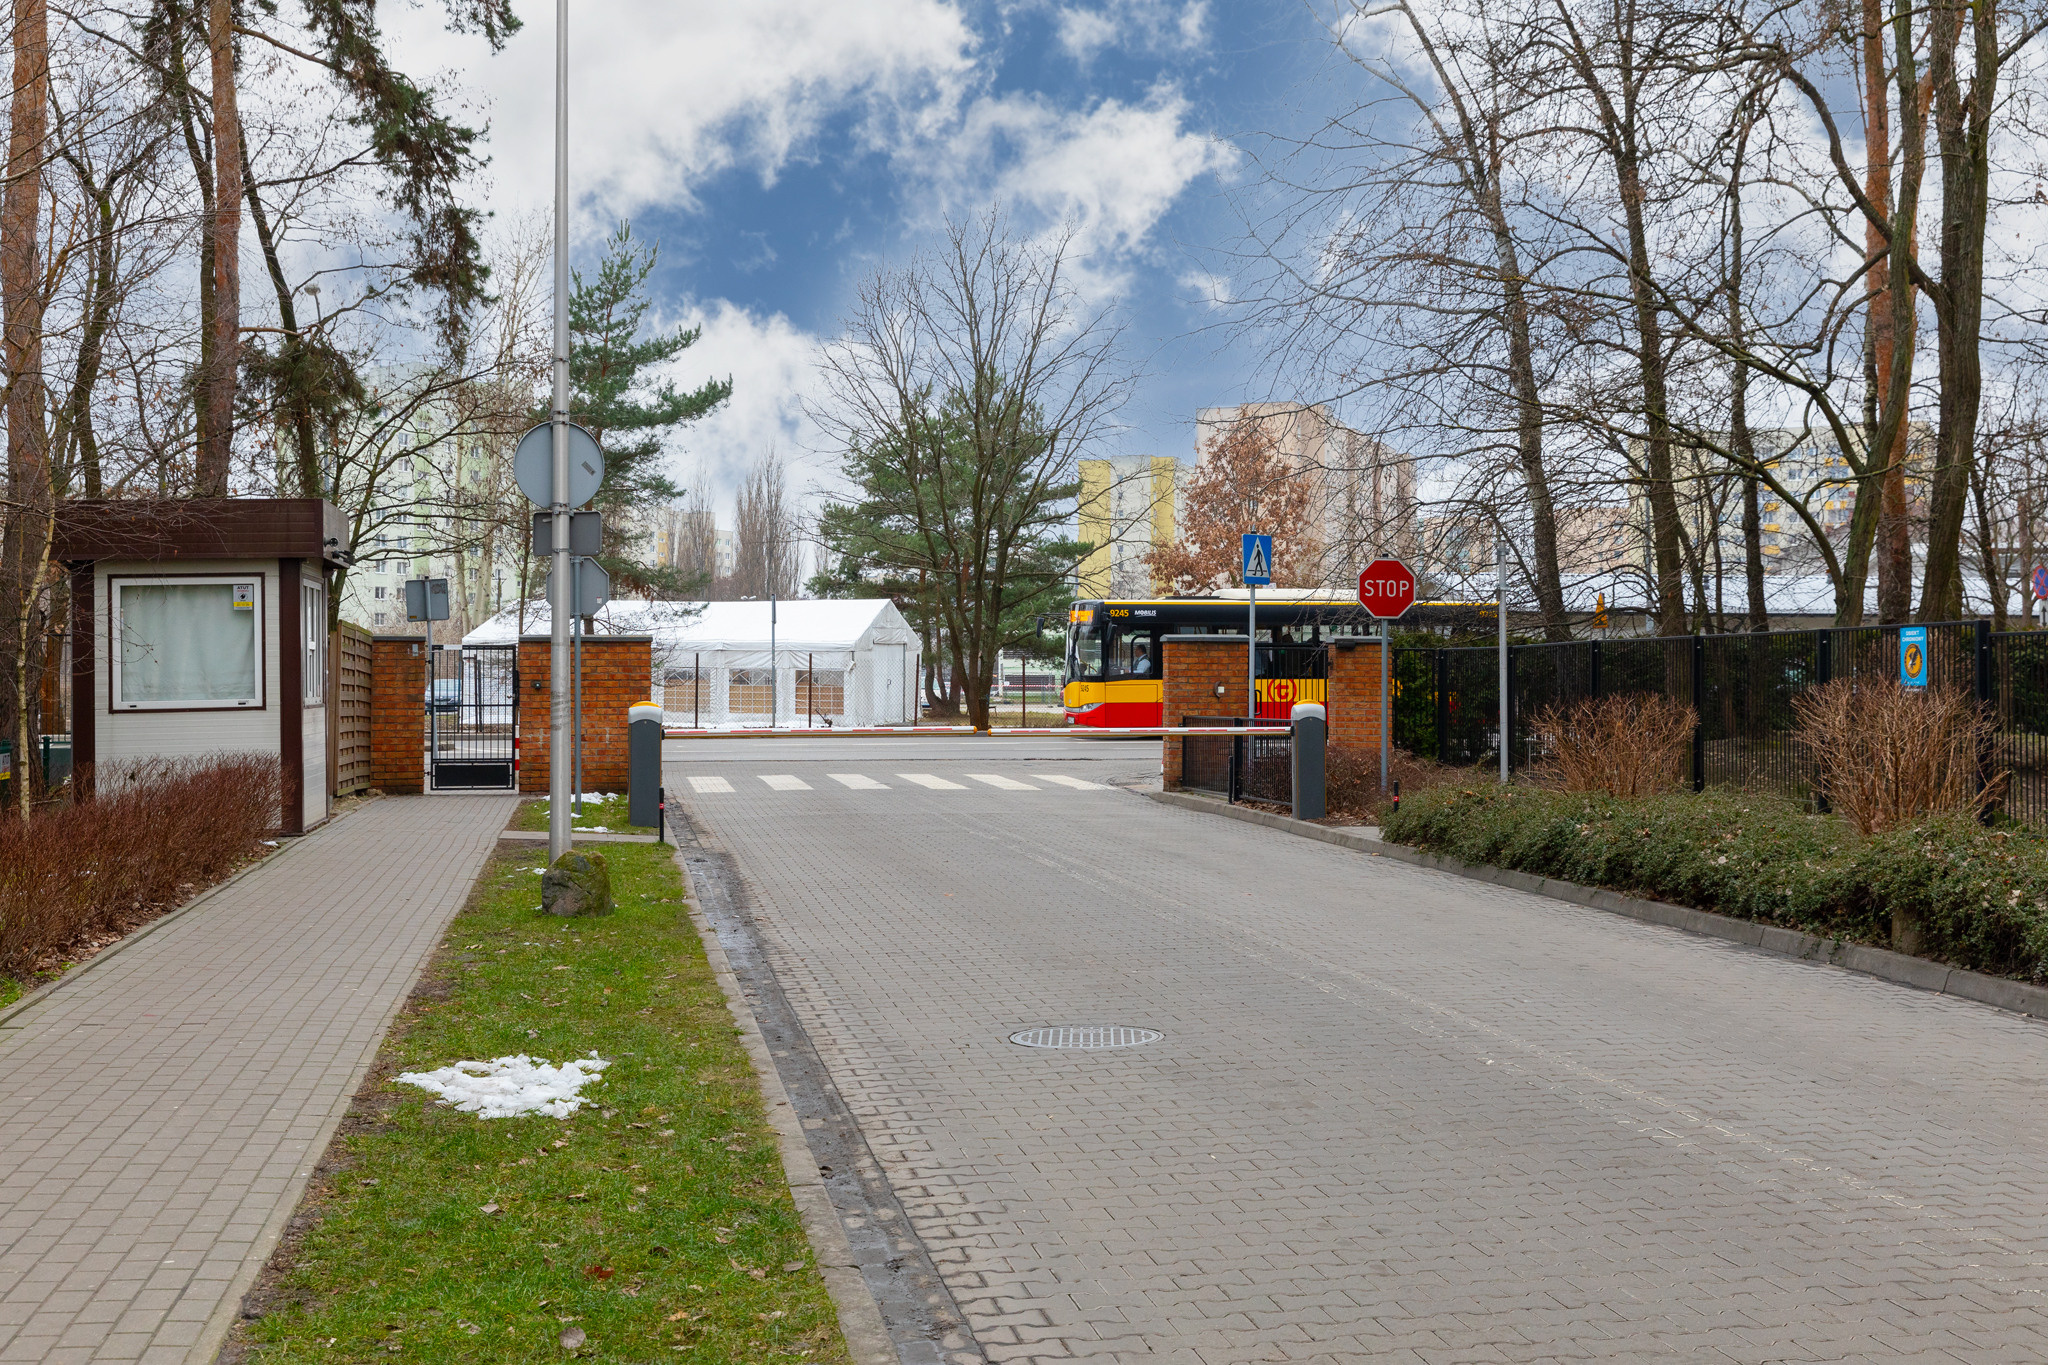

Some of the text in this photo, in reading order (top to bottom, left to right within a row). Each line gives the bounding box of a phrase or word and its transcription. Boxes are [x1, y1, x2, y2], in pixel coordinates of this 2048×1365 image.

[1364, 579, 1410, 597] STOP
[1109, 609, 1129, 617] 9245
[1134, 609, 1157, 617] MOBILIS
